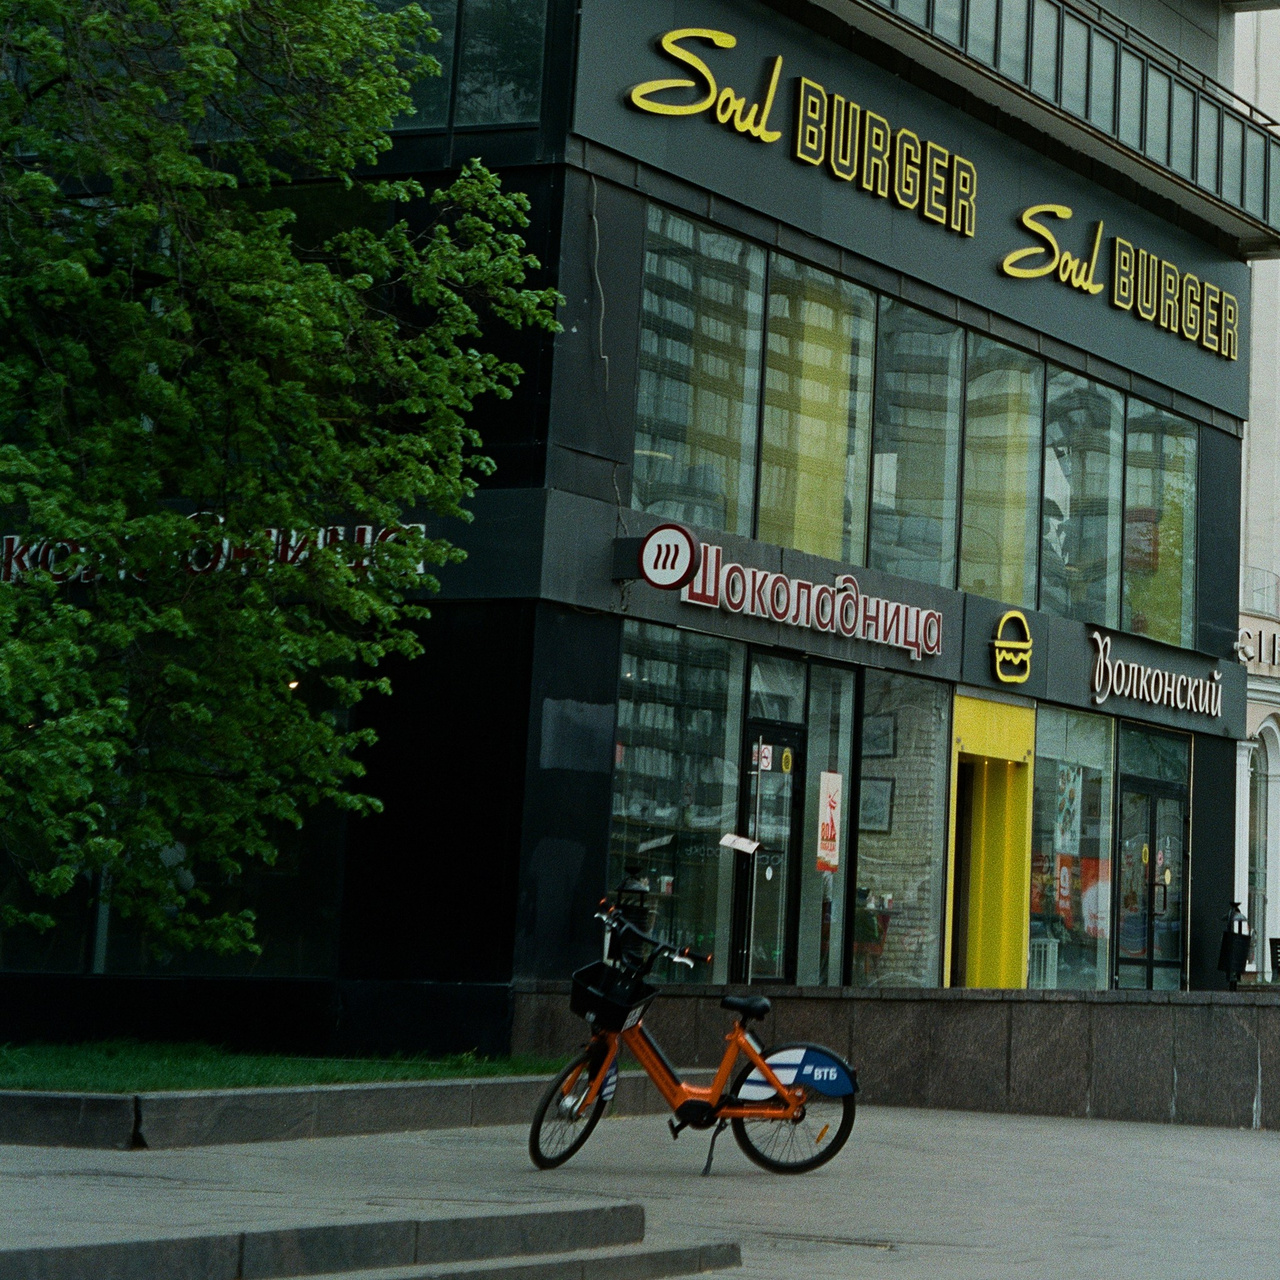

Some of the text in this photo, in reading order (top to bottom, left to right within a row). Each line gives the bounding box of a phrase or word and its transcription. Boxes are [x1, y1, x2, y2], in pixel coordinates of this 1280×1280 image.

[630, 27, 976, 238] Soul BURGER
[1001, 203, 1238, 361] Soul BURGER
[681, 543, 943, 661] Шоколадница
[1091, 630, 1222, 718] Волконский
